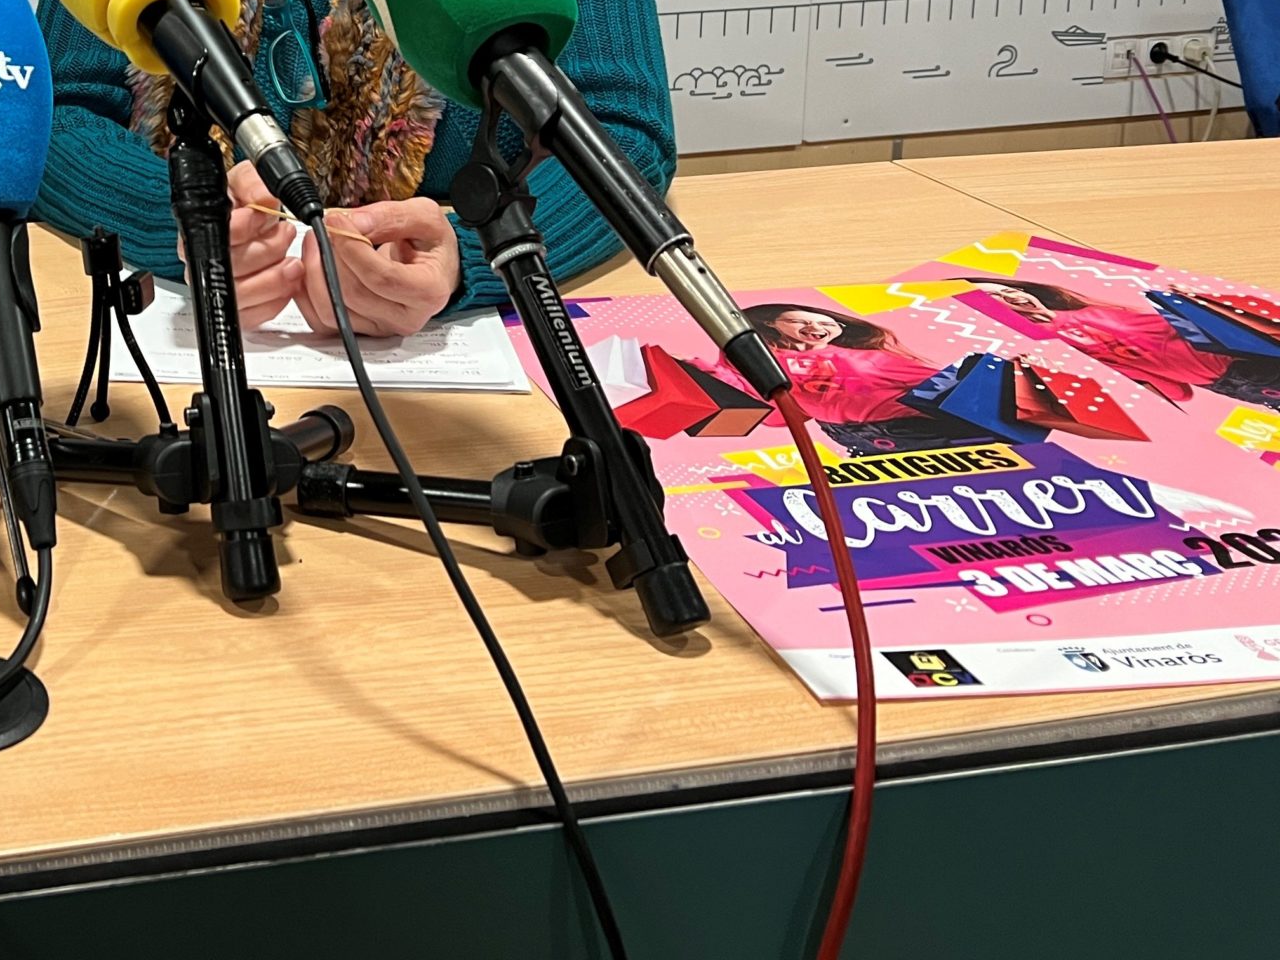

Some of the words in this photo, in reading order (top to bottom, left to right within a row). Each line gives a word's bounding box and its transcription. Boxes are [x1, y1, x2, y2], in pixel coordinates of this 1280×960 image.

[532, 275, 592, 386] Millenium
[823, 449, 1019, 485] BOTIGUES
[757, 520, 803, 545] al
[783, 476, 1156, 548] Carrer
[958, 566, 1009, 597] 3
[996, 562, 1075, 593] DE
[1055, 550, 1204, 587] MARÇ
[1183, 528, 1280, 569] 20
[1101, 645, 1176, 656] Ajuntament
[1176, 642, 1193, 651] de
[1111, 651, 1223, 668] Vinaròs
